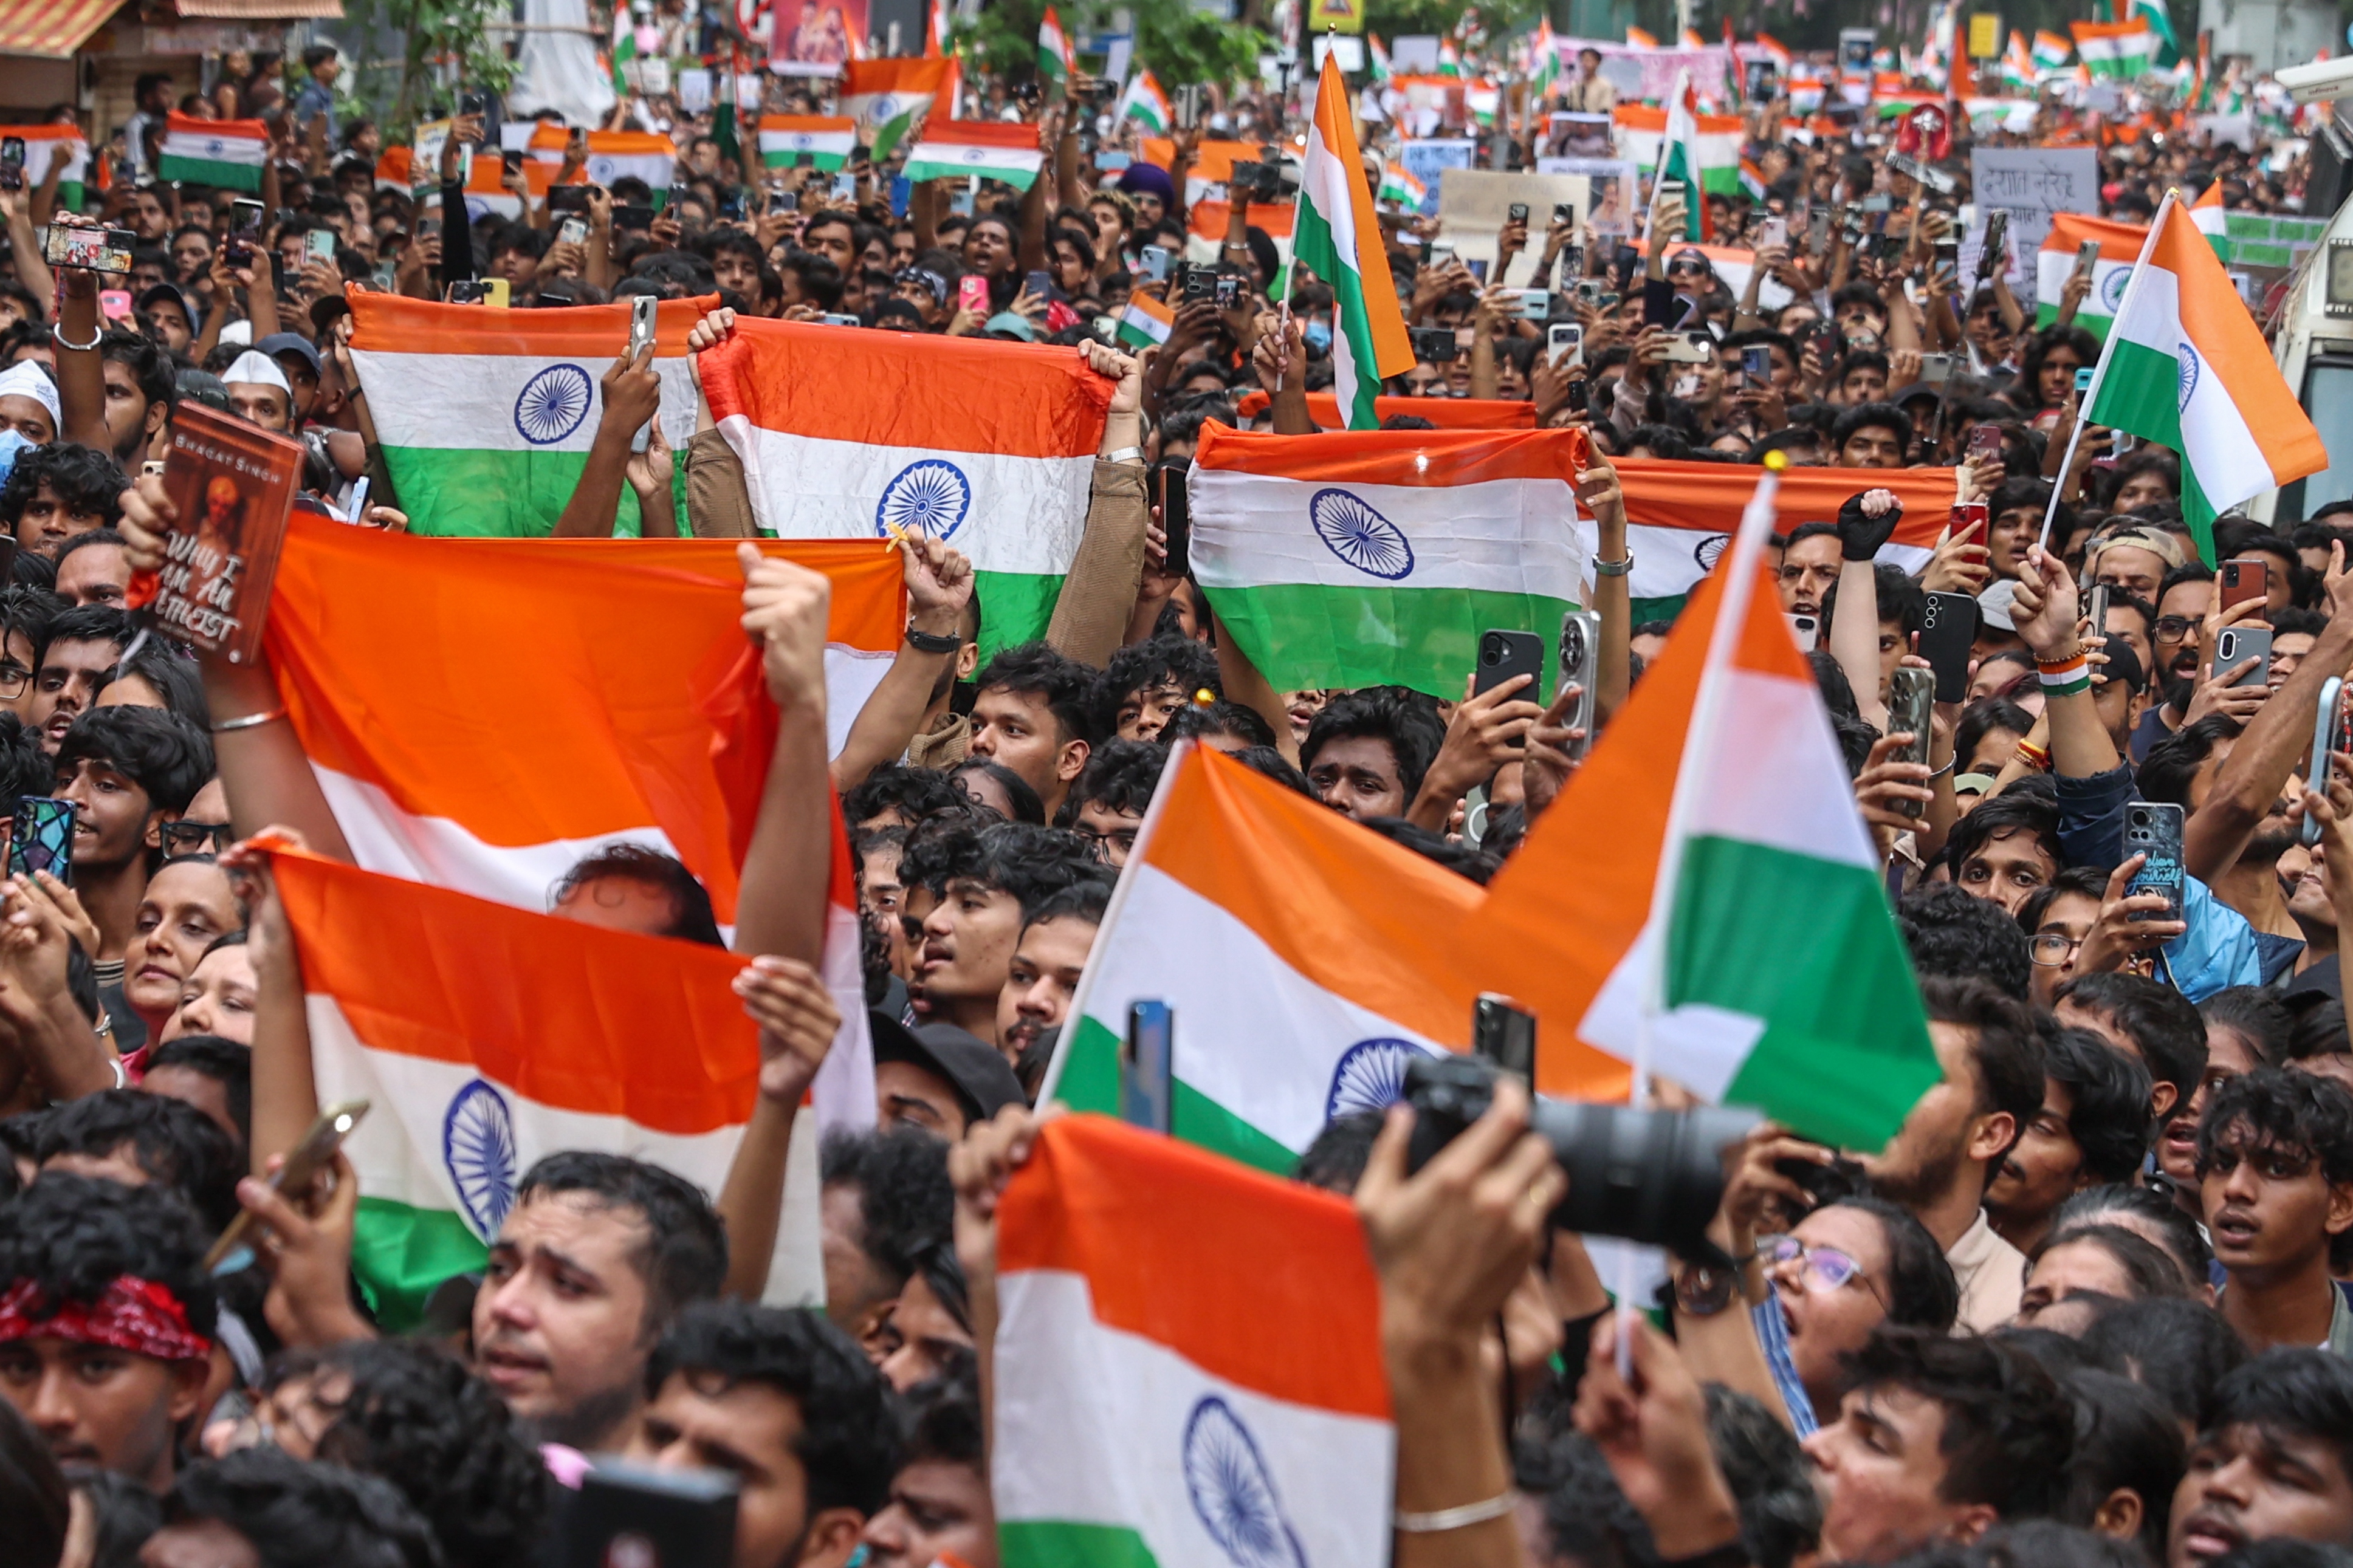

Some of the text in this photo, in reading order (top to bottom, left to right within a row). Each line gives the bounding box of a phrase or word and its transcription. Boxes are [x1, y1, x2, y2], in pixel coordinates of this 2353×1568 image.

[175, 433, 282, 484] BHAGAT SINGH
[221, 554, 242, 584] I
